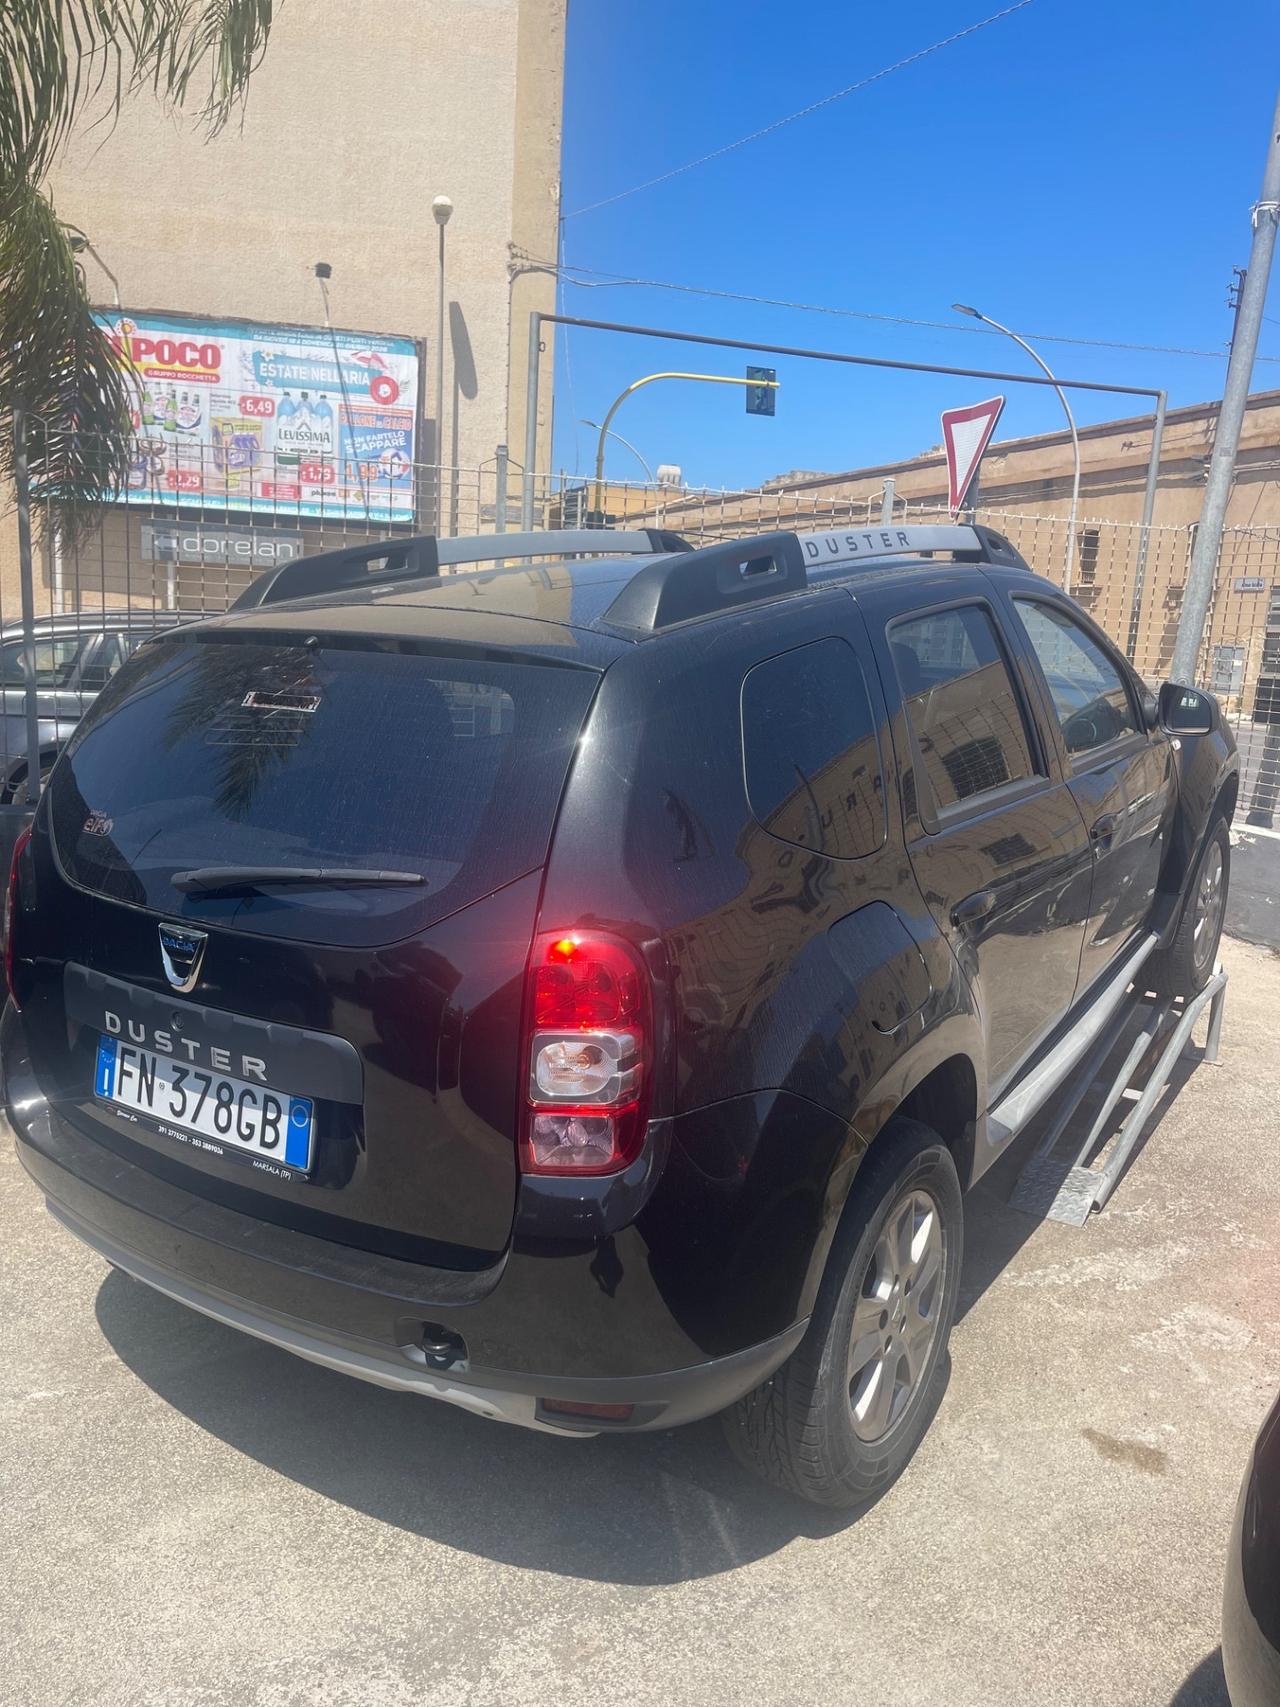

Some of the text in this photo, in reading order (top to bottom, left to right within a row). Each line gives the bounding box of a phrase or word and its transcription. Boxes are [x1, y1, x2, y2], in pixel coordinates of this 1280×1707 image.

[131, 338, 221, 370] POCO
[259, 363, 307, 381] ESTATE
[278, 428, 330, 443] LEVISSIMA
[345, 437, 407, 454] SCAPPARE
[183, 526, 293, 557] dorelan
[805, 531, 910, 558] DUSTER
[105, 1010, 268, 1081] DUSTER
[117, 1047, 157, 1107] FN
[158, 1125, 167, 1134] 391
[191, 1138, 202, 1147] 353
[252, 1160, 292, 1181] MARSALA (TP)
